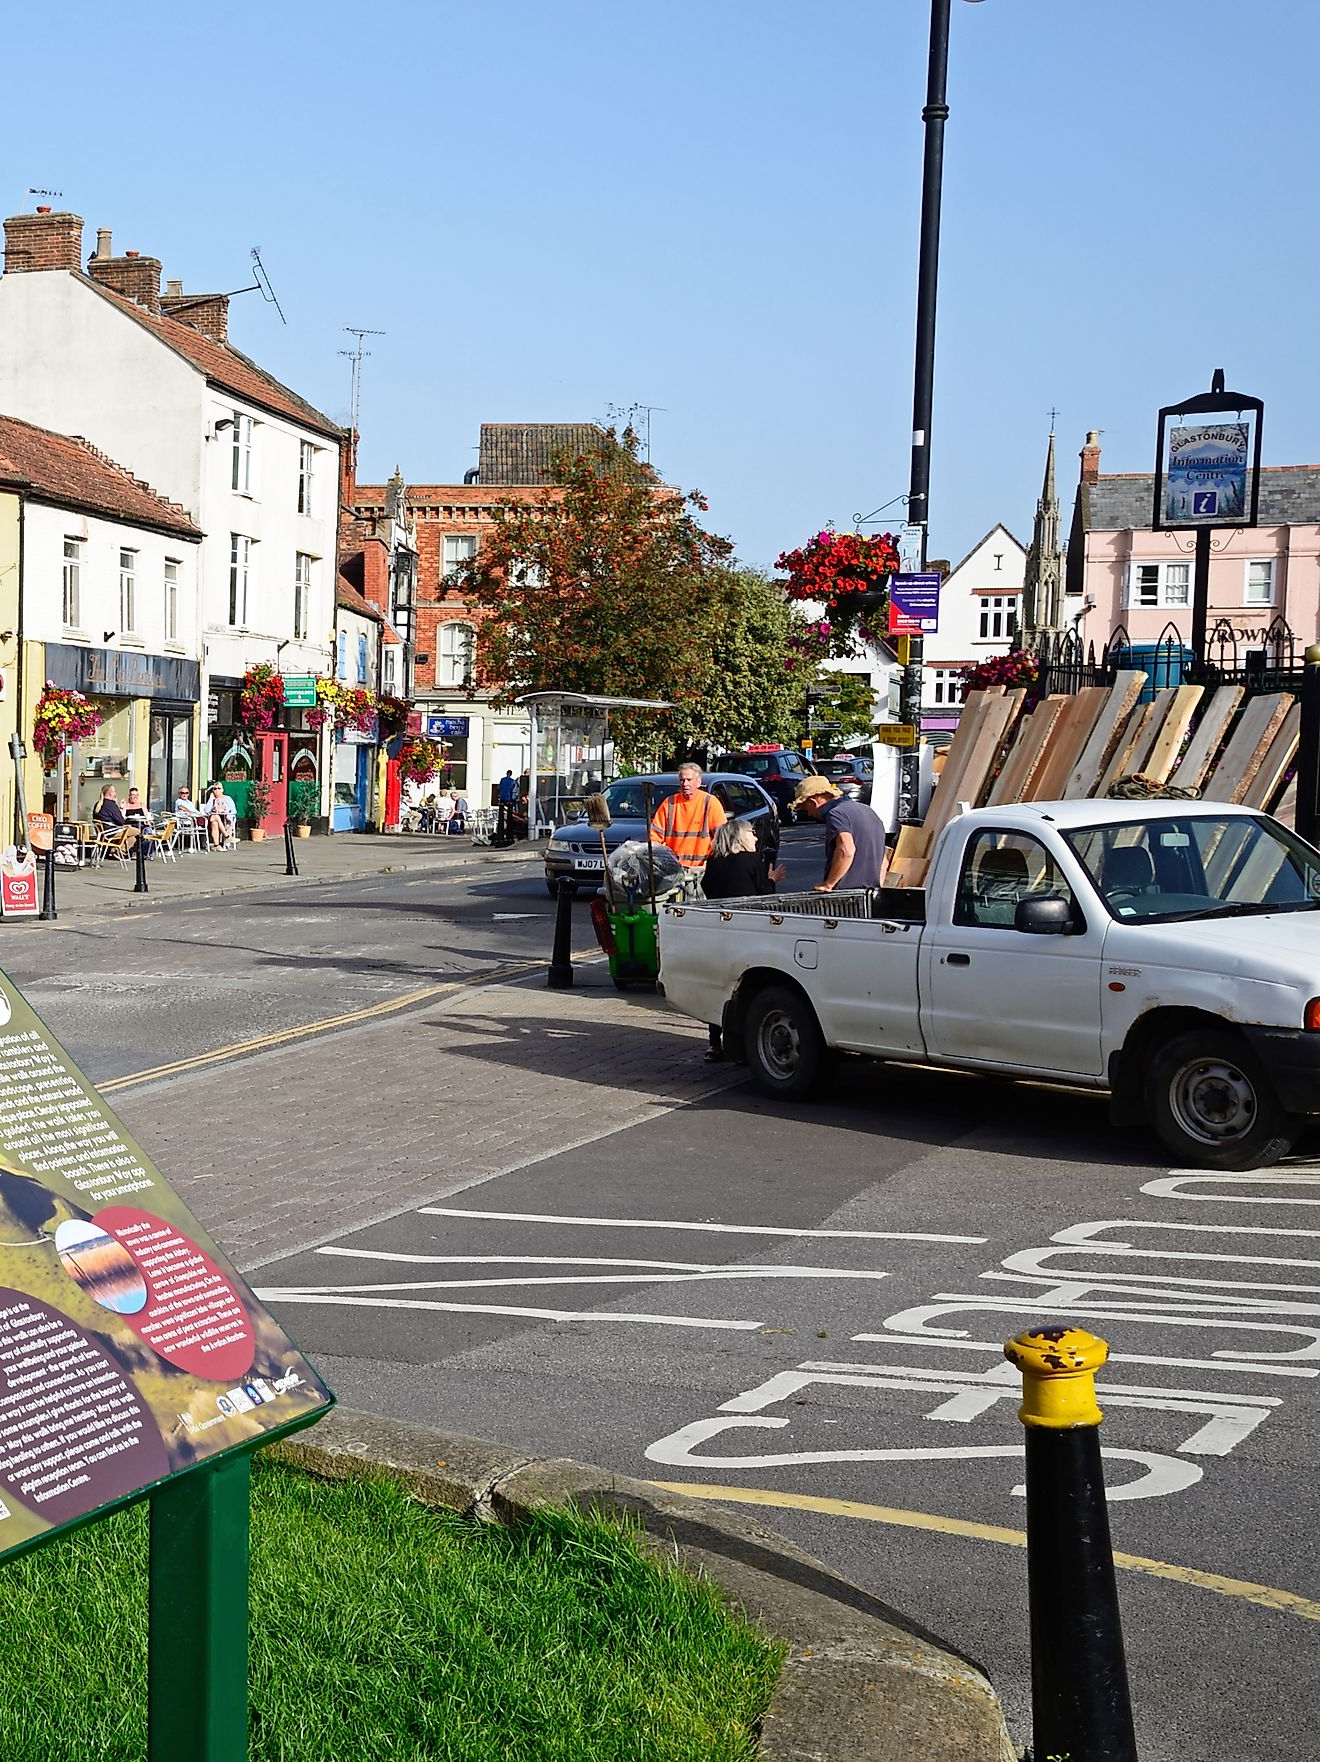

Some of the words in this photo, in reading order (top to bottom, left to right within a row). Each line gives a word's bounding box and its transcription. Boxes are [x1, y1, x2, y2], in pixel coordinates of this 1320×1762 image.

[1171, 433, 1246, 453] GLASTONBURY
[1173, 454, 1243, 467] Information
[1187, 470, 1225, 480] Centre
[28, 822, 53, 830] COFFEE
[1, 1046, 34, 1057] ramblers
[33, 1042, 49, 1052] and
[31, 1055, 52, 1065] Way
[141, 1255, 168, 1268] supporting
[272, 1374, 299, 1390] MENDIP
